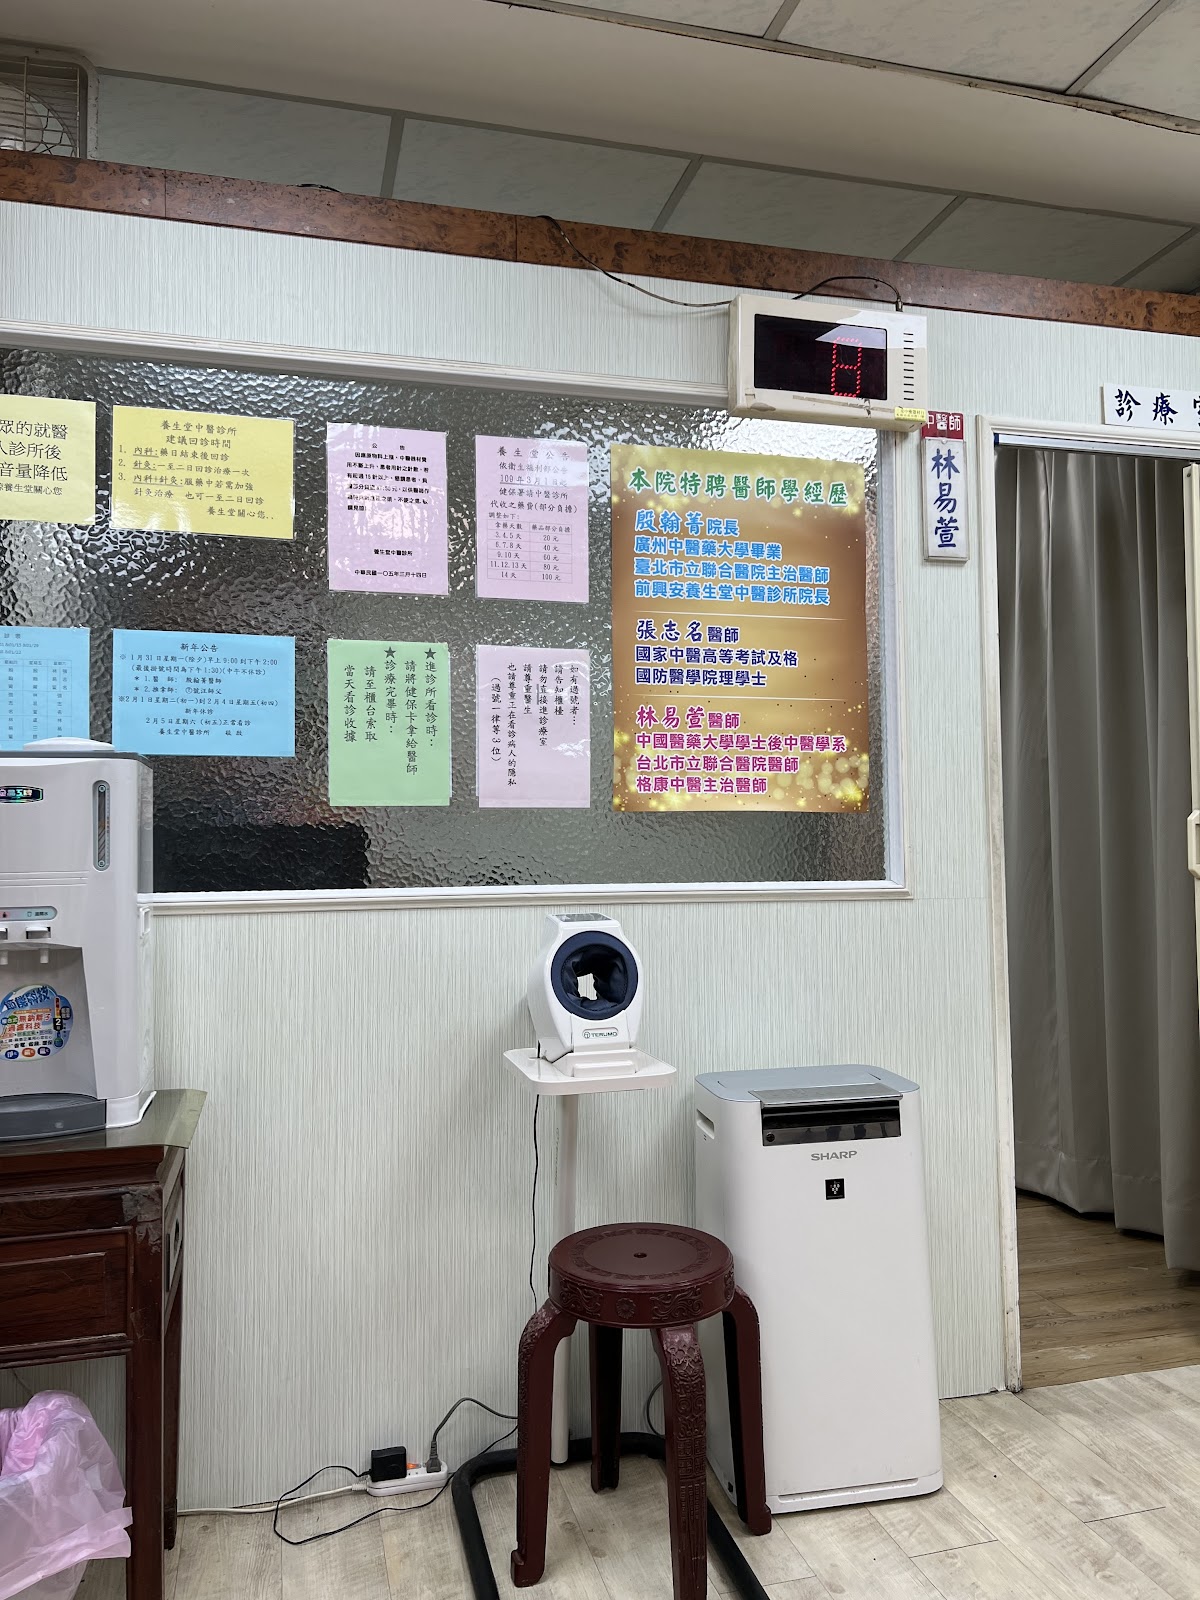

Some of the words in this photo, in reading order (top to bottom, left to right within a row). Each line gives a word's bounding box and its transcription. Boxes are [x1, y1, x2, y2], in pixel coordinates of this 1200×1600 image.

[830, 336, 863, 398] 8
[160, 419, 238, 437] 養生堂中醫診所
[165, 434, 232, 449] 建議回診時間
[628, 467, 849, 506] 本院特聘醫師學經歷
[930, 447, 960, 548] 林易萱
[634, 536, 782, 560] 廣州中醫藥大學畢業
[634, 558, 830, 584] 臺北市立聯合醫院主治醫師
[634, 580, 830, 605] 前興安養生堂中醫診所院長
[636, 619, 739, 643] 張志名醫師
[179, 643, 219, 653] 新年公告
[635, 645, 798, 667] 國家中醫高等考試及格
[635, 667, 767, 687] 國防醫學院理學士
[344, 664, 357, 743] 當天看診收據
[364, 665, 378, 742] 請至櫃台索取
[404, 660, 419, 775] 請將健保卡拿給醫師
[636, 706, 740, 729] 林易萱醫師
[636, 733, 847, 752] 中國醫藥大學學士後中醫學系
[636, 755, 799, 773] 台北市立聯合醫院醫師
[636, 776, 767, 793] 格康中醫主治醫師
[810, 1150, 858, 1161] SHARP
